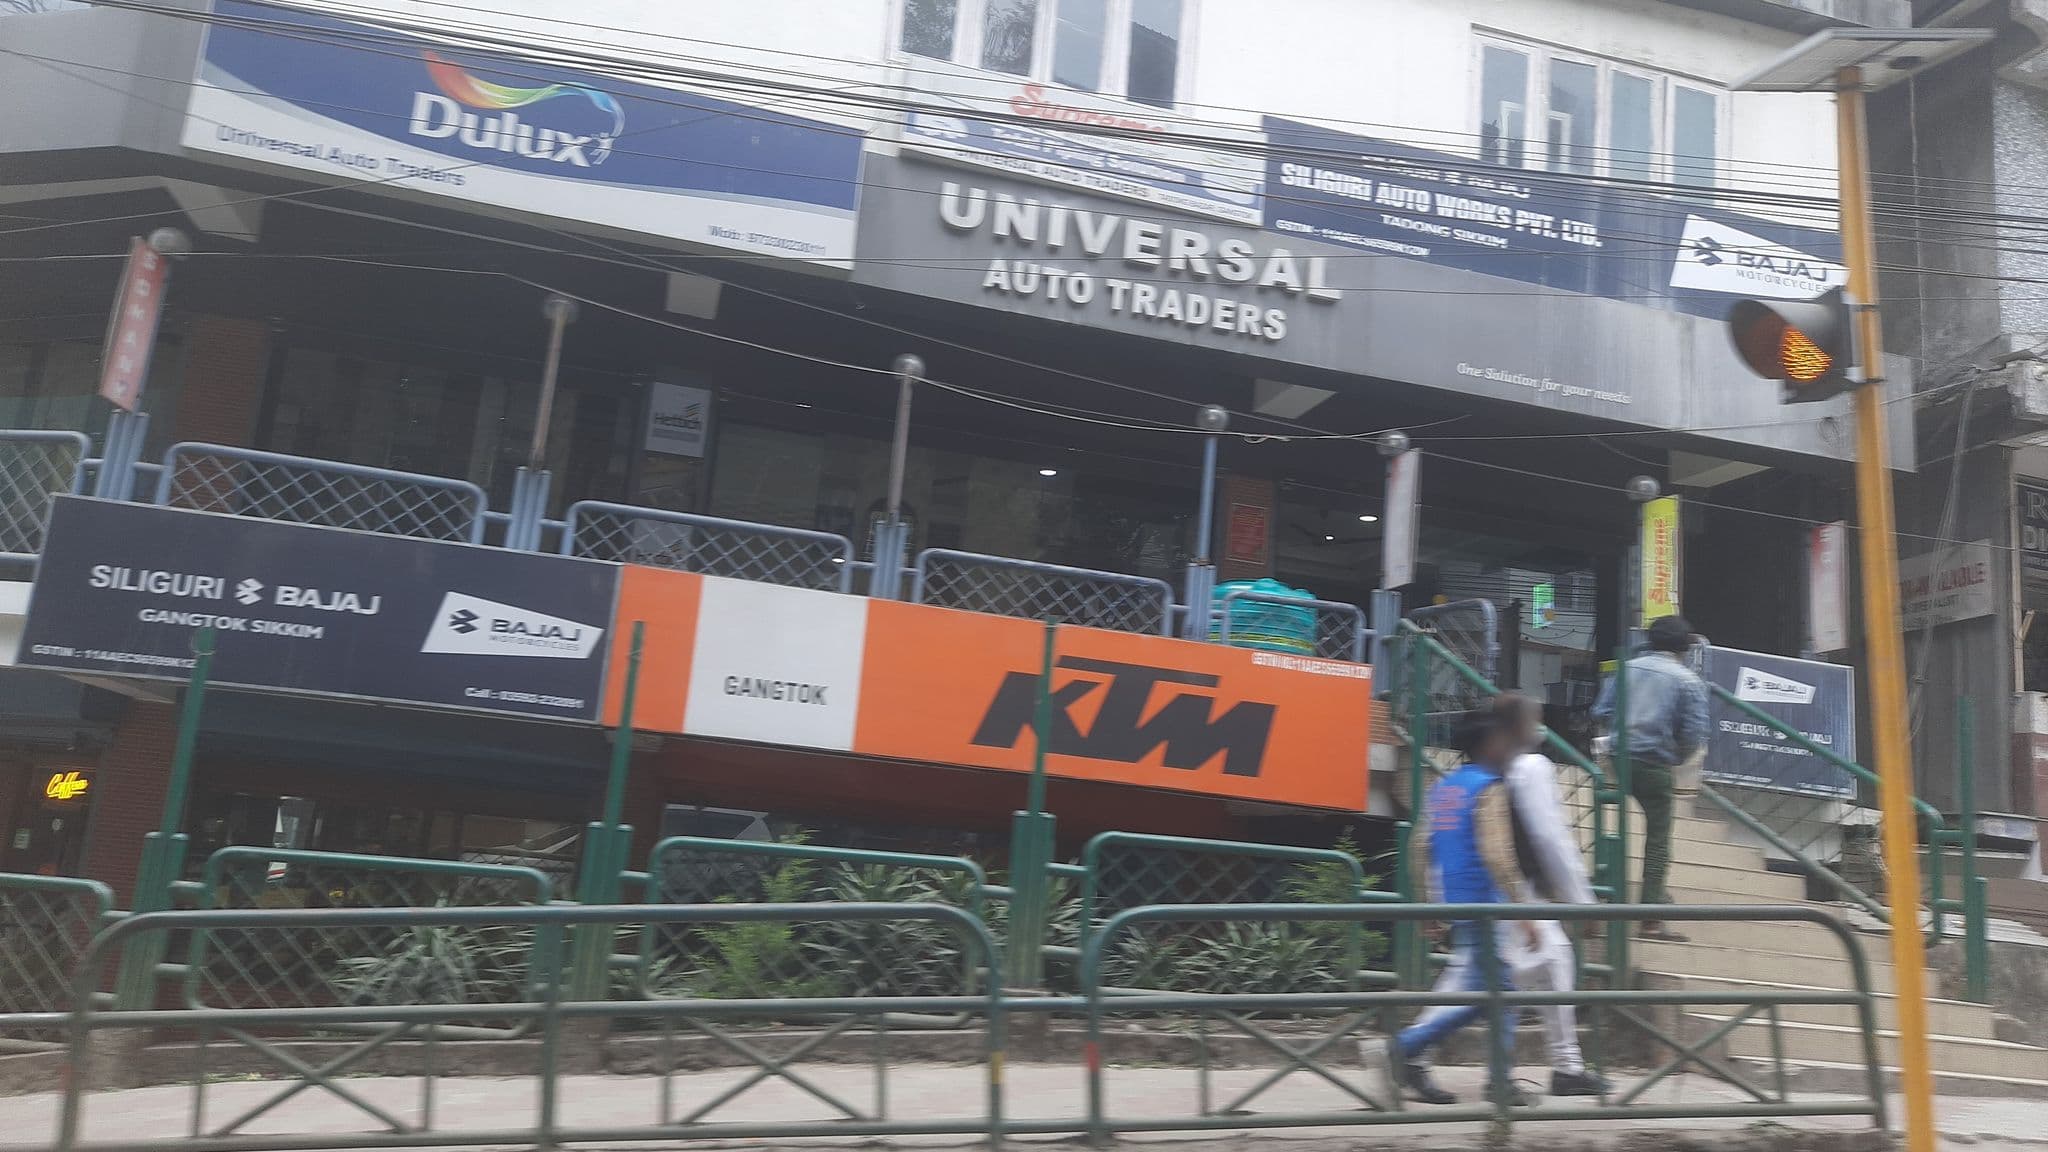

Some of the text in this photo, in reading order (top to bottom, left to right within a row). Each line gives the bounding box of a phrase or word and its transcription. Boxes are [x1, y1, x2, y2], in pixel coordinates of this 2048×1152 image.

[409, 91, 597, 167] Dulux
[327, 144, 379, 170] Auto
[388, 157, 467, 187] Traders
[1281, 163, 1373, 202] SILIGURI
[1375, 182, 1431, 213] AUTO
[1436, 193, 1513, 229] WORKS
[940, 181, 1343, 302] UNIVERSAL
[1379, 214, 1451, 238] TADONG
[1736, 250, 1829, 283] BAJAJ
[982, 259, 1289, 342] AUTO TRADERS
[88, 564, 383, 616] SILIGURI BAJAJ
[138, 608, 326, 640] GANGTOK SIKKIM
[490, 618, 582, 642] BAJAJ
[723, 675, 829, 706] GANGTOK
[968, 654, 1281, 778] KTM
